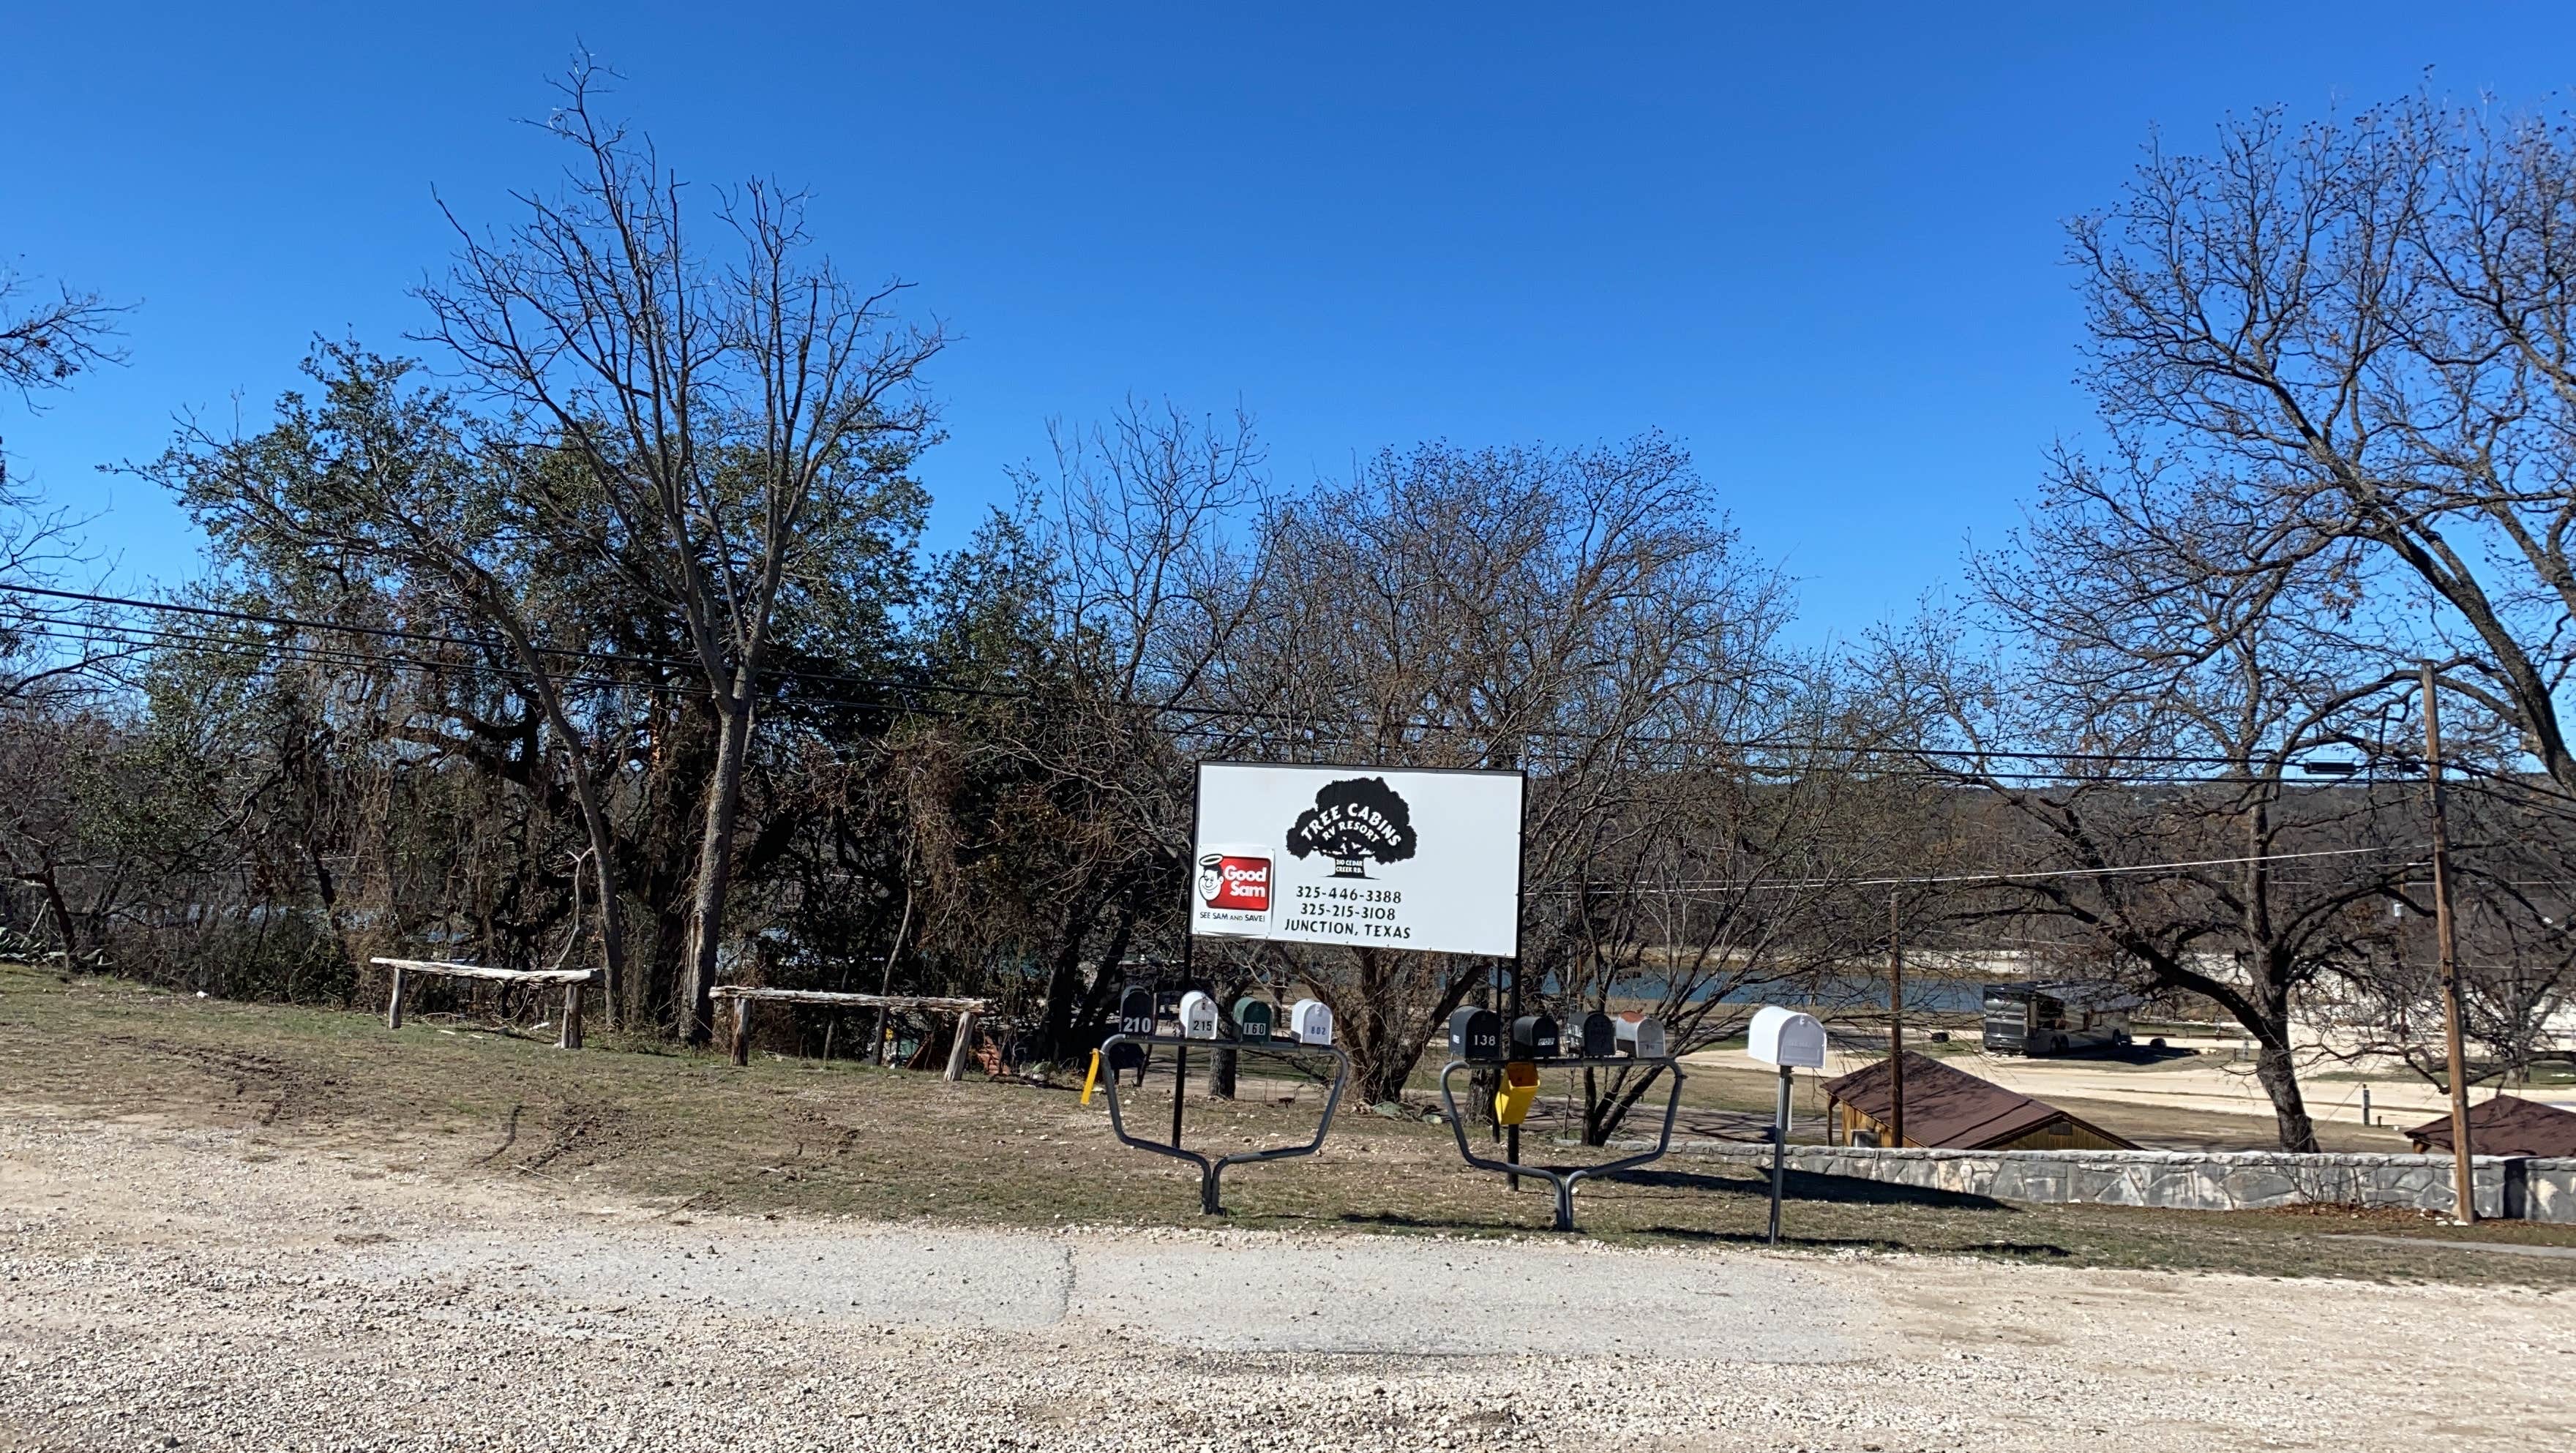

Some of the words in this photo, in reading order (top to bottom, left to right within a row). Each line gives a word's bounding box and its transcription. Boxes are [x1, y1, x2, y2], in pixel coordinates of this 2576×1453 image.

[1300, 805, 1341, 841] TREE
[1347, 803, 1402, 846] CABINS
[1322, 827, 1336, 841] RV
[1338, 820, 1381, 843] RESORT
[1224, 865, 1267, 882] Good
[1229, 880, 1265, 898] Sam
[1296, 885, 1401, 904] 325-446-3388
[1200, 912, 1210, 920] SEE
[1213, 912, 1229, 920] SAM
[1245, 914, 1265, 923] SAVE!
[1300, 903, 1396, 920] 325-215-3108
[1284, 918, 1359, 936] JUNCTION,
[1364, 924, 1411, 939] TEXAS
[1123, 1017, 1152, 1033] 210
[1193, 1020, 1213, 1032] 215
[1246, 1024, 1265, 1035] 160
[1474, 1035, 1496, 1046] 138
